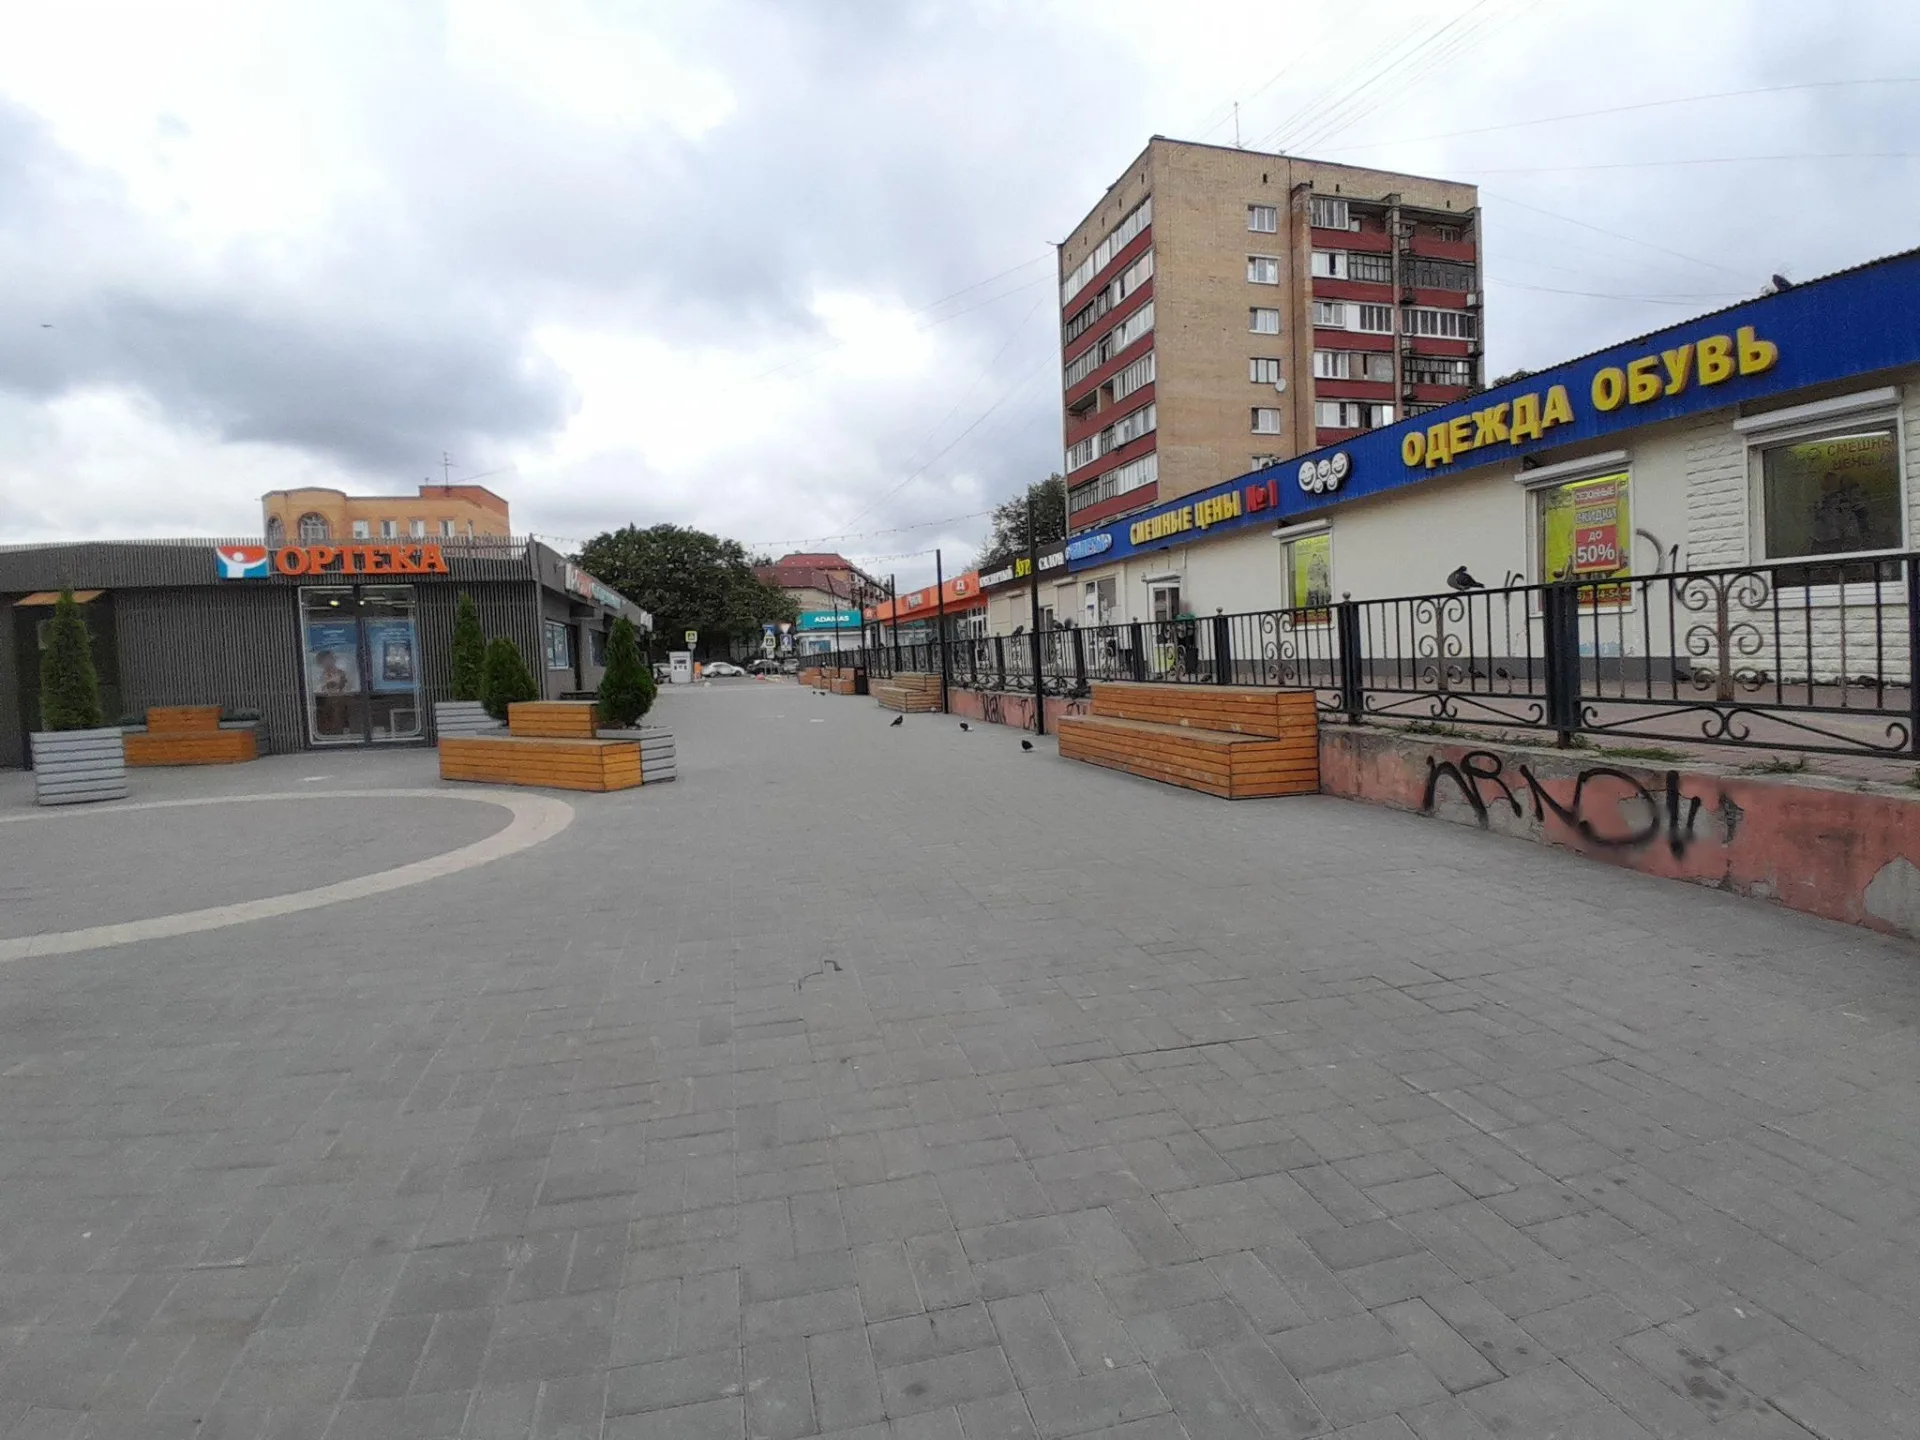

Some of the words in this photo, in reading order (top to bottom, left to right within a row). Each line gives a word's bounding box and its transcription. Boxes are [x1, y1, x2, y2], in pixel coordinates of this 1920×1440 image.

[1402, 385, 1575, 469] ОДЕЖДА
[1591, 326, 1778, 411] ОБУВЬ
[1130, 506, 1192, 545] СМЕШНЫЕ
[1194, 490, 1242, 529] ЦЕНЫ
[1577, 544, 1615, 563] 50%
